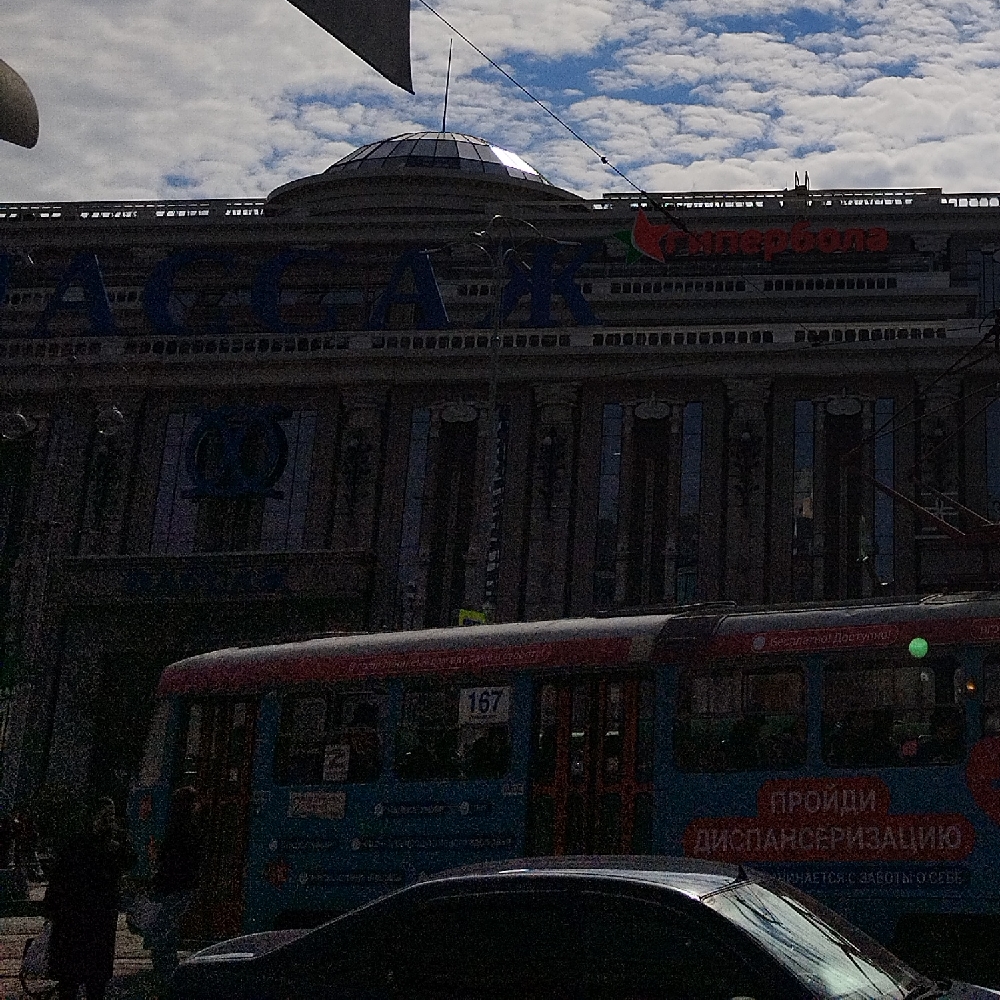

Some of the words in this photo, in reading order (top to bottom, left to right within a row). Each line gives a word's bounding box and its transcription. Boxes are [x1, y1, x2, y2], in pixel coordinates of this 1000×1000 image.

[0, 240, 603, 338] АССАЖ
[468, 690, 503, 713] 167
[769, 784, 877, 817] ПРОЙДИ
[693, 825, 963, 855] ДИСПАНСЕРИЗАЦИЮ
[860, 871, 913, 884] ЗАБОТЫ
[916, 871, 926, 884] О
[928, 871, 963, 885] СЕБЕ
